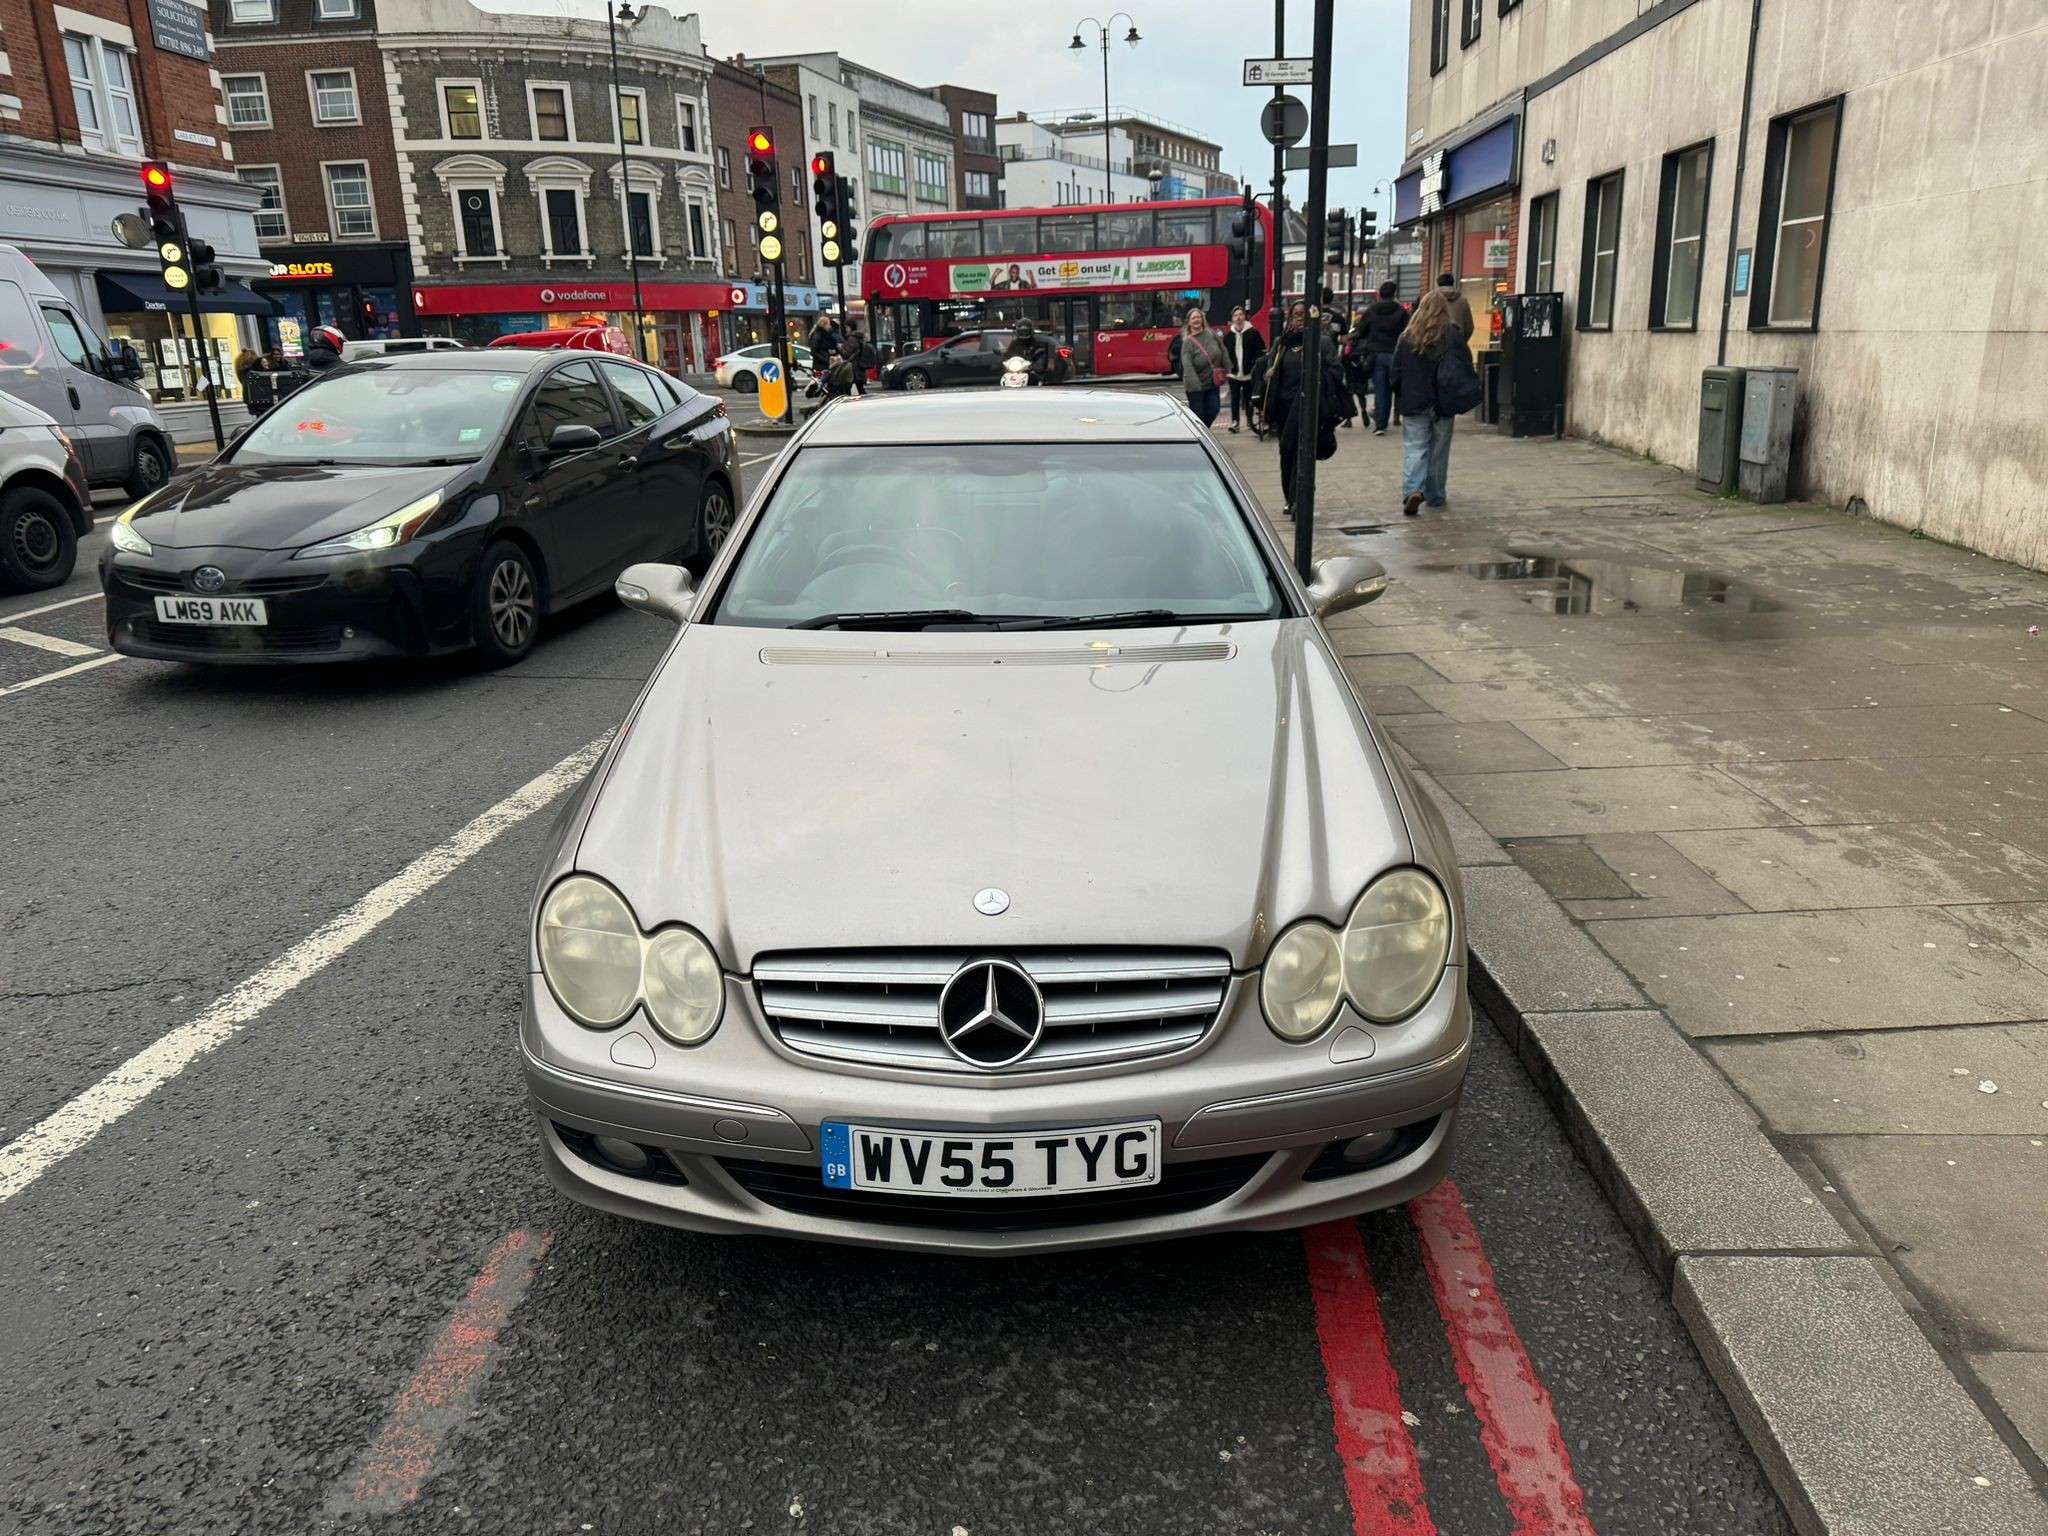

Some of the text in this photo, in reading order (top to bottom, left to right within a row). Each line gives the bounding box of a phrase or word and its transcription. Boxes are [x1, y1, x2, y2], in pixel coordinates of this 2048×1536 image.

[288, 262, 333, 275] SLOTS
[1038, 266, 1056, 276] Get
[1080, 265, 1094, 274] on
[1095, 263, 1112, 273] us!
[557, 289, 607, 301] vodafone
[163, 600, 258, 622] LM69 AKK
[860, 1130, 1148, 1188] WV55 TYG
[827, 1163, 846, 1178] GB
